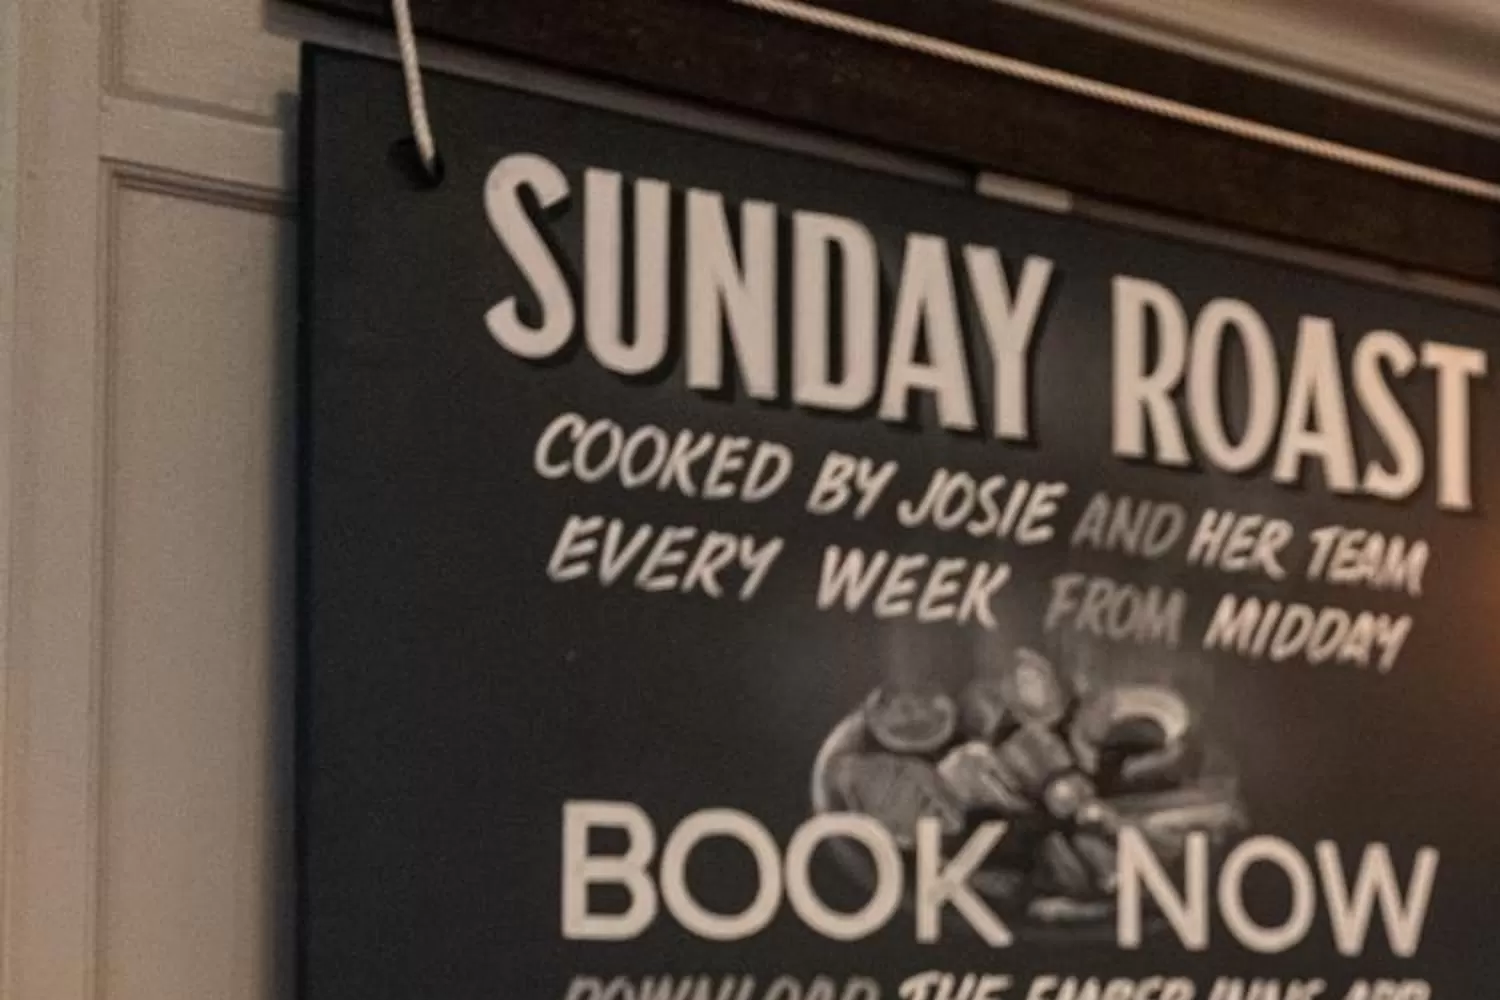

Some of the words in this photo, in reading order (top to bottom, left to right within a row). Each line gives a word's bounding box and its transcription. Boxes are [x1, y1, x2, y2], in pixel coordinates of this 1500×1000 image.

[484, 152, 1053, 440] SUNDAY
[1112, 275, 1486, 510] ROAST
[534, 412, 793, 503] COOKED
[807, 450, 897, 519] BY
[897, 467, 1069, 544] JOSIE
[1072, 493, 1185, 557] AND
[1188, 508, 1292, 579] HER
[1307, 525, 1431, 597] TEAM
[547, 515, 784, 601] EVERY
[816, 545, 1010, 629] WEEK
[1043, 573, 1185, 644] FROM
[1203, 594, 1413, 674] MIDDAY
[561, 798, 1013, 948] BOOK
[1116, 825, 1439, 957] NOW
